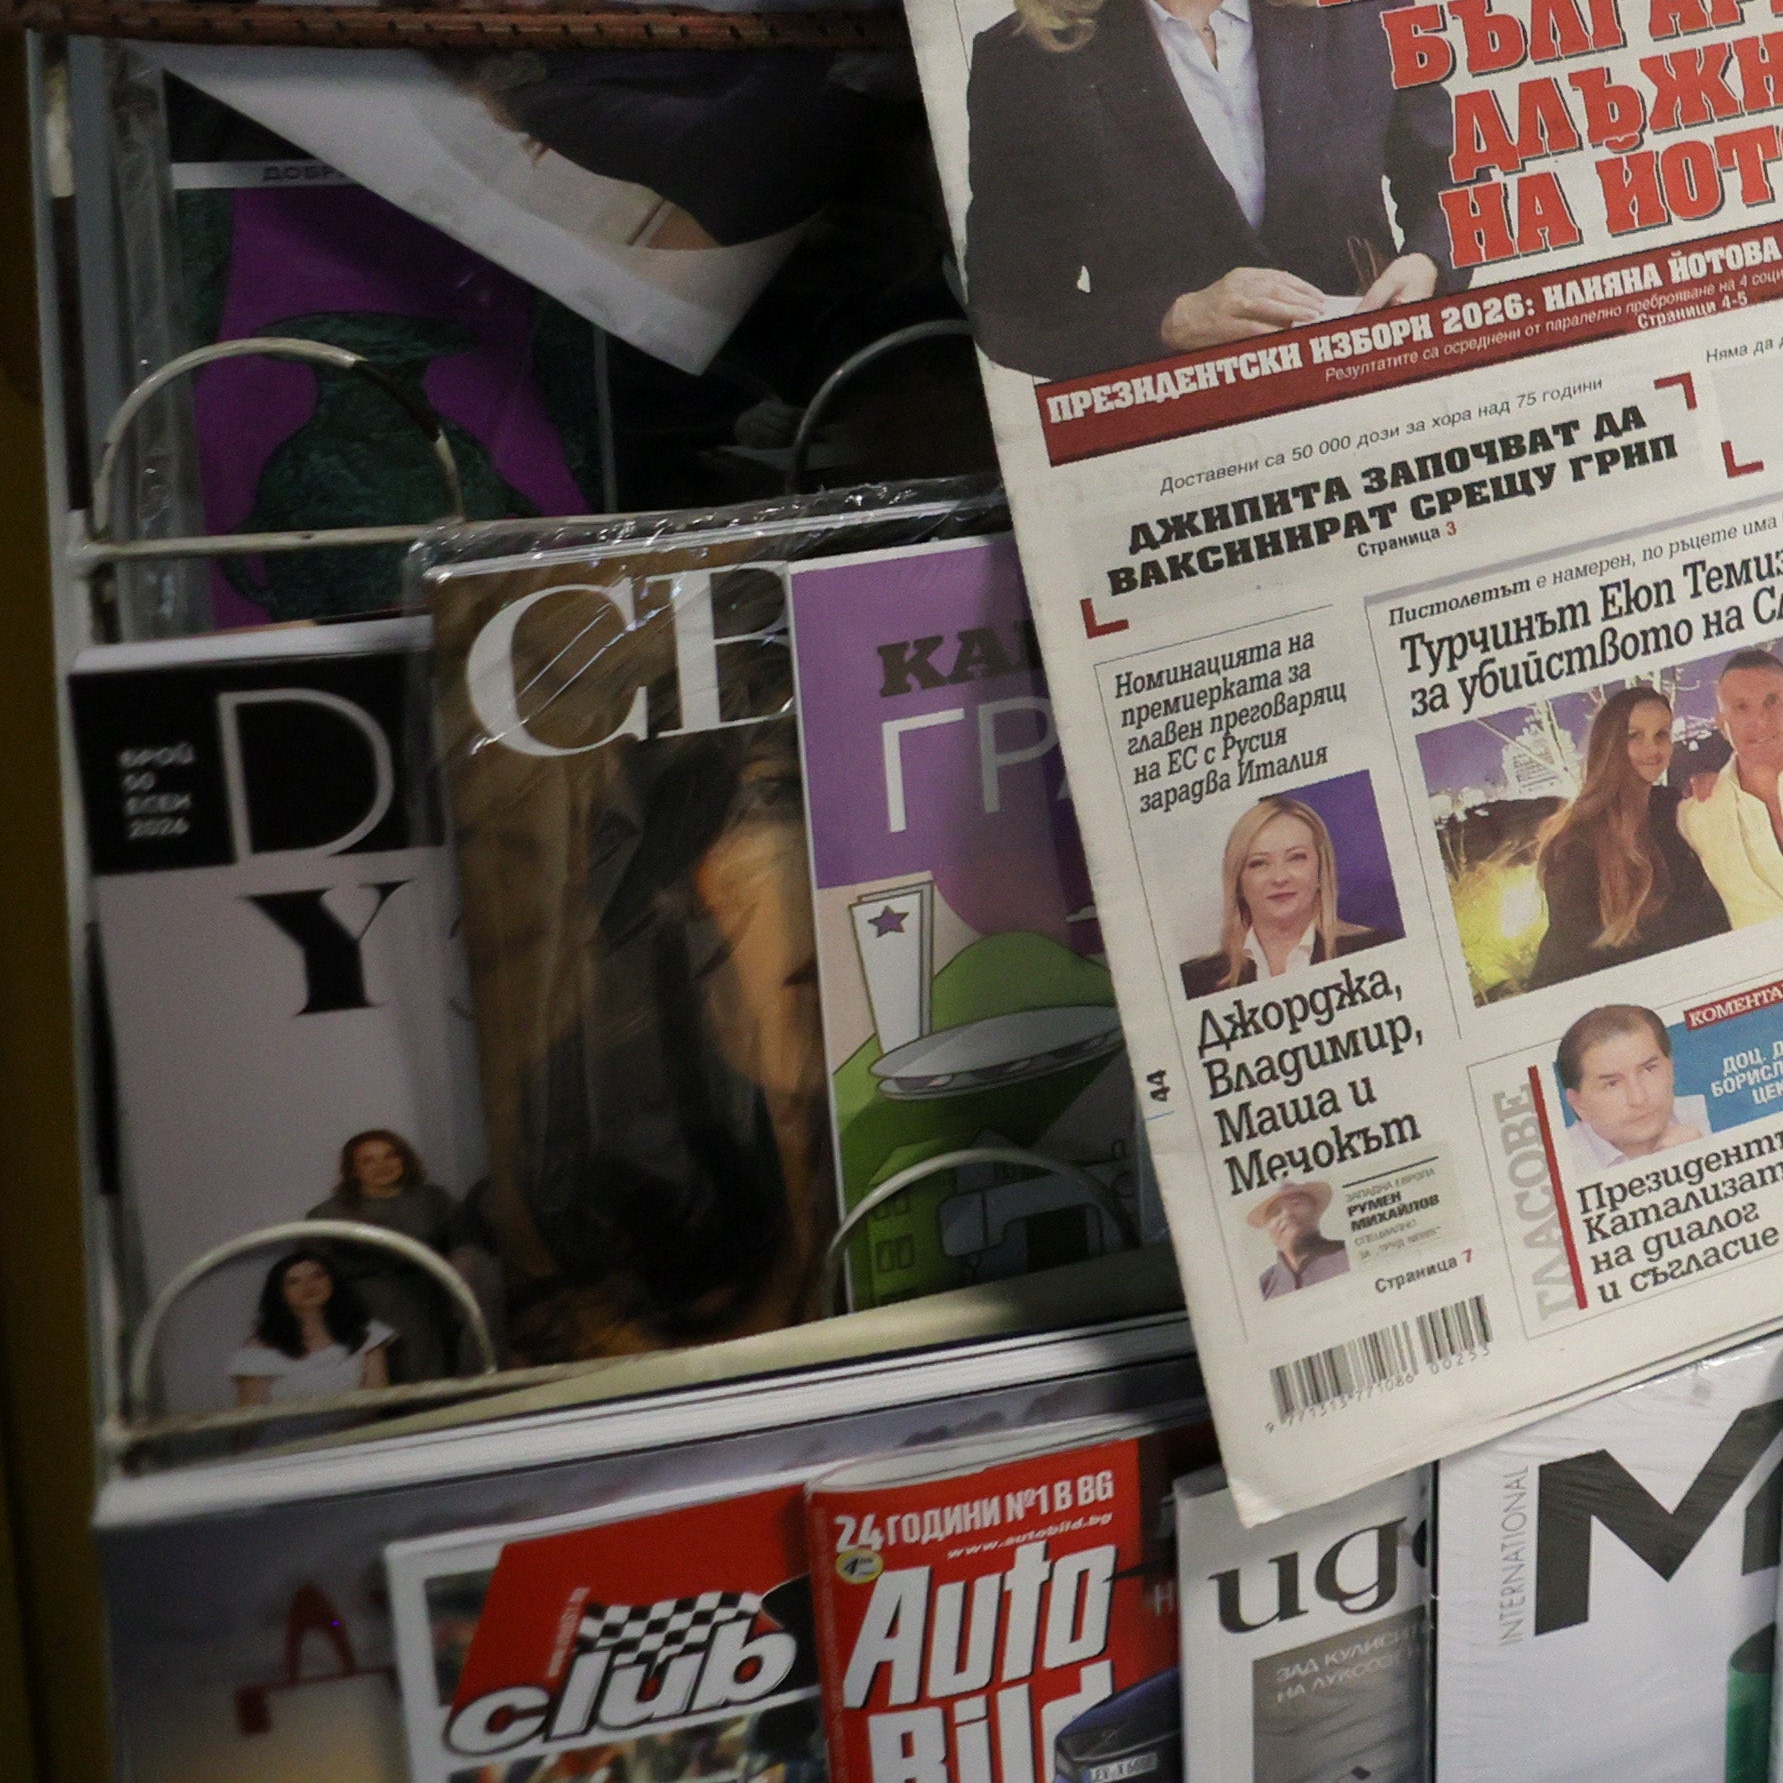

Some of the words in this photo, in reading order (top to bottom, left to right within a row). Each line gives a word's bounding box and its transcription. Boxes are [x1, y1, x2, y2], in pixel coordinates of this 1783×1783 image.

[1437, 165, 1582, 274] НА
[1046, 340, 1303, 429] ПРЕЗИДЕНТСКИ
[1308, 311, 1433, 367] ИЗБОРИ
[1439, 288, 1535, 337] 2026:
[1541, 260, 1662, 315] ИЛИЯНА
[1666, 227, 1783, 288] ЙОТОВА
[1106, 497, 1399, 602] ВАКСИНИРАТ
[1408, 461, 1559, 526] СРЕЩУ
[1569, 432, 1678, 485] ГРИП
[1124, 470, 1352, 557] ДЖИПИТА
[1359, 414, 1582, 499] ЗАПОЧВАТ
[1589, 402, 1647, 442] ДА
[1398, 587, 1593, 682] Турчинът
[1598, 567, 1677, 626] Еюп
[1409, 680, 1450, 717] за
[1455, 603, 1696, 713] убийството
[1699, 599, 1756, 641] на
[1191, 948, 1404, 1066] Джорджа,
[1203, 992, 1425, 1117] Владимир,
[1213, 1072, 1341, 1155] Маша
[1348, 1076, 1377, 1110] и
[1224, 1094, 1421, 1204] Мечокът
[834, 1513, 884, 1553] 24
[887, 1496, 1000, 1546] ГОДИНИ
[1077, 1470, 1114, 1507] BG
[947, 1512, 1113, 1560] www.autobild.bg
[1500, 1465, 1530, 1648] INTERNATIONAL
[843, 1540, 1117, 1709] Auto
[444, 1622, 797, 1756] club
